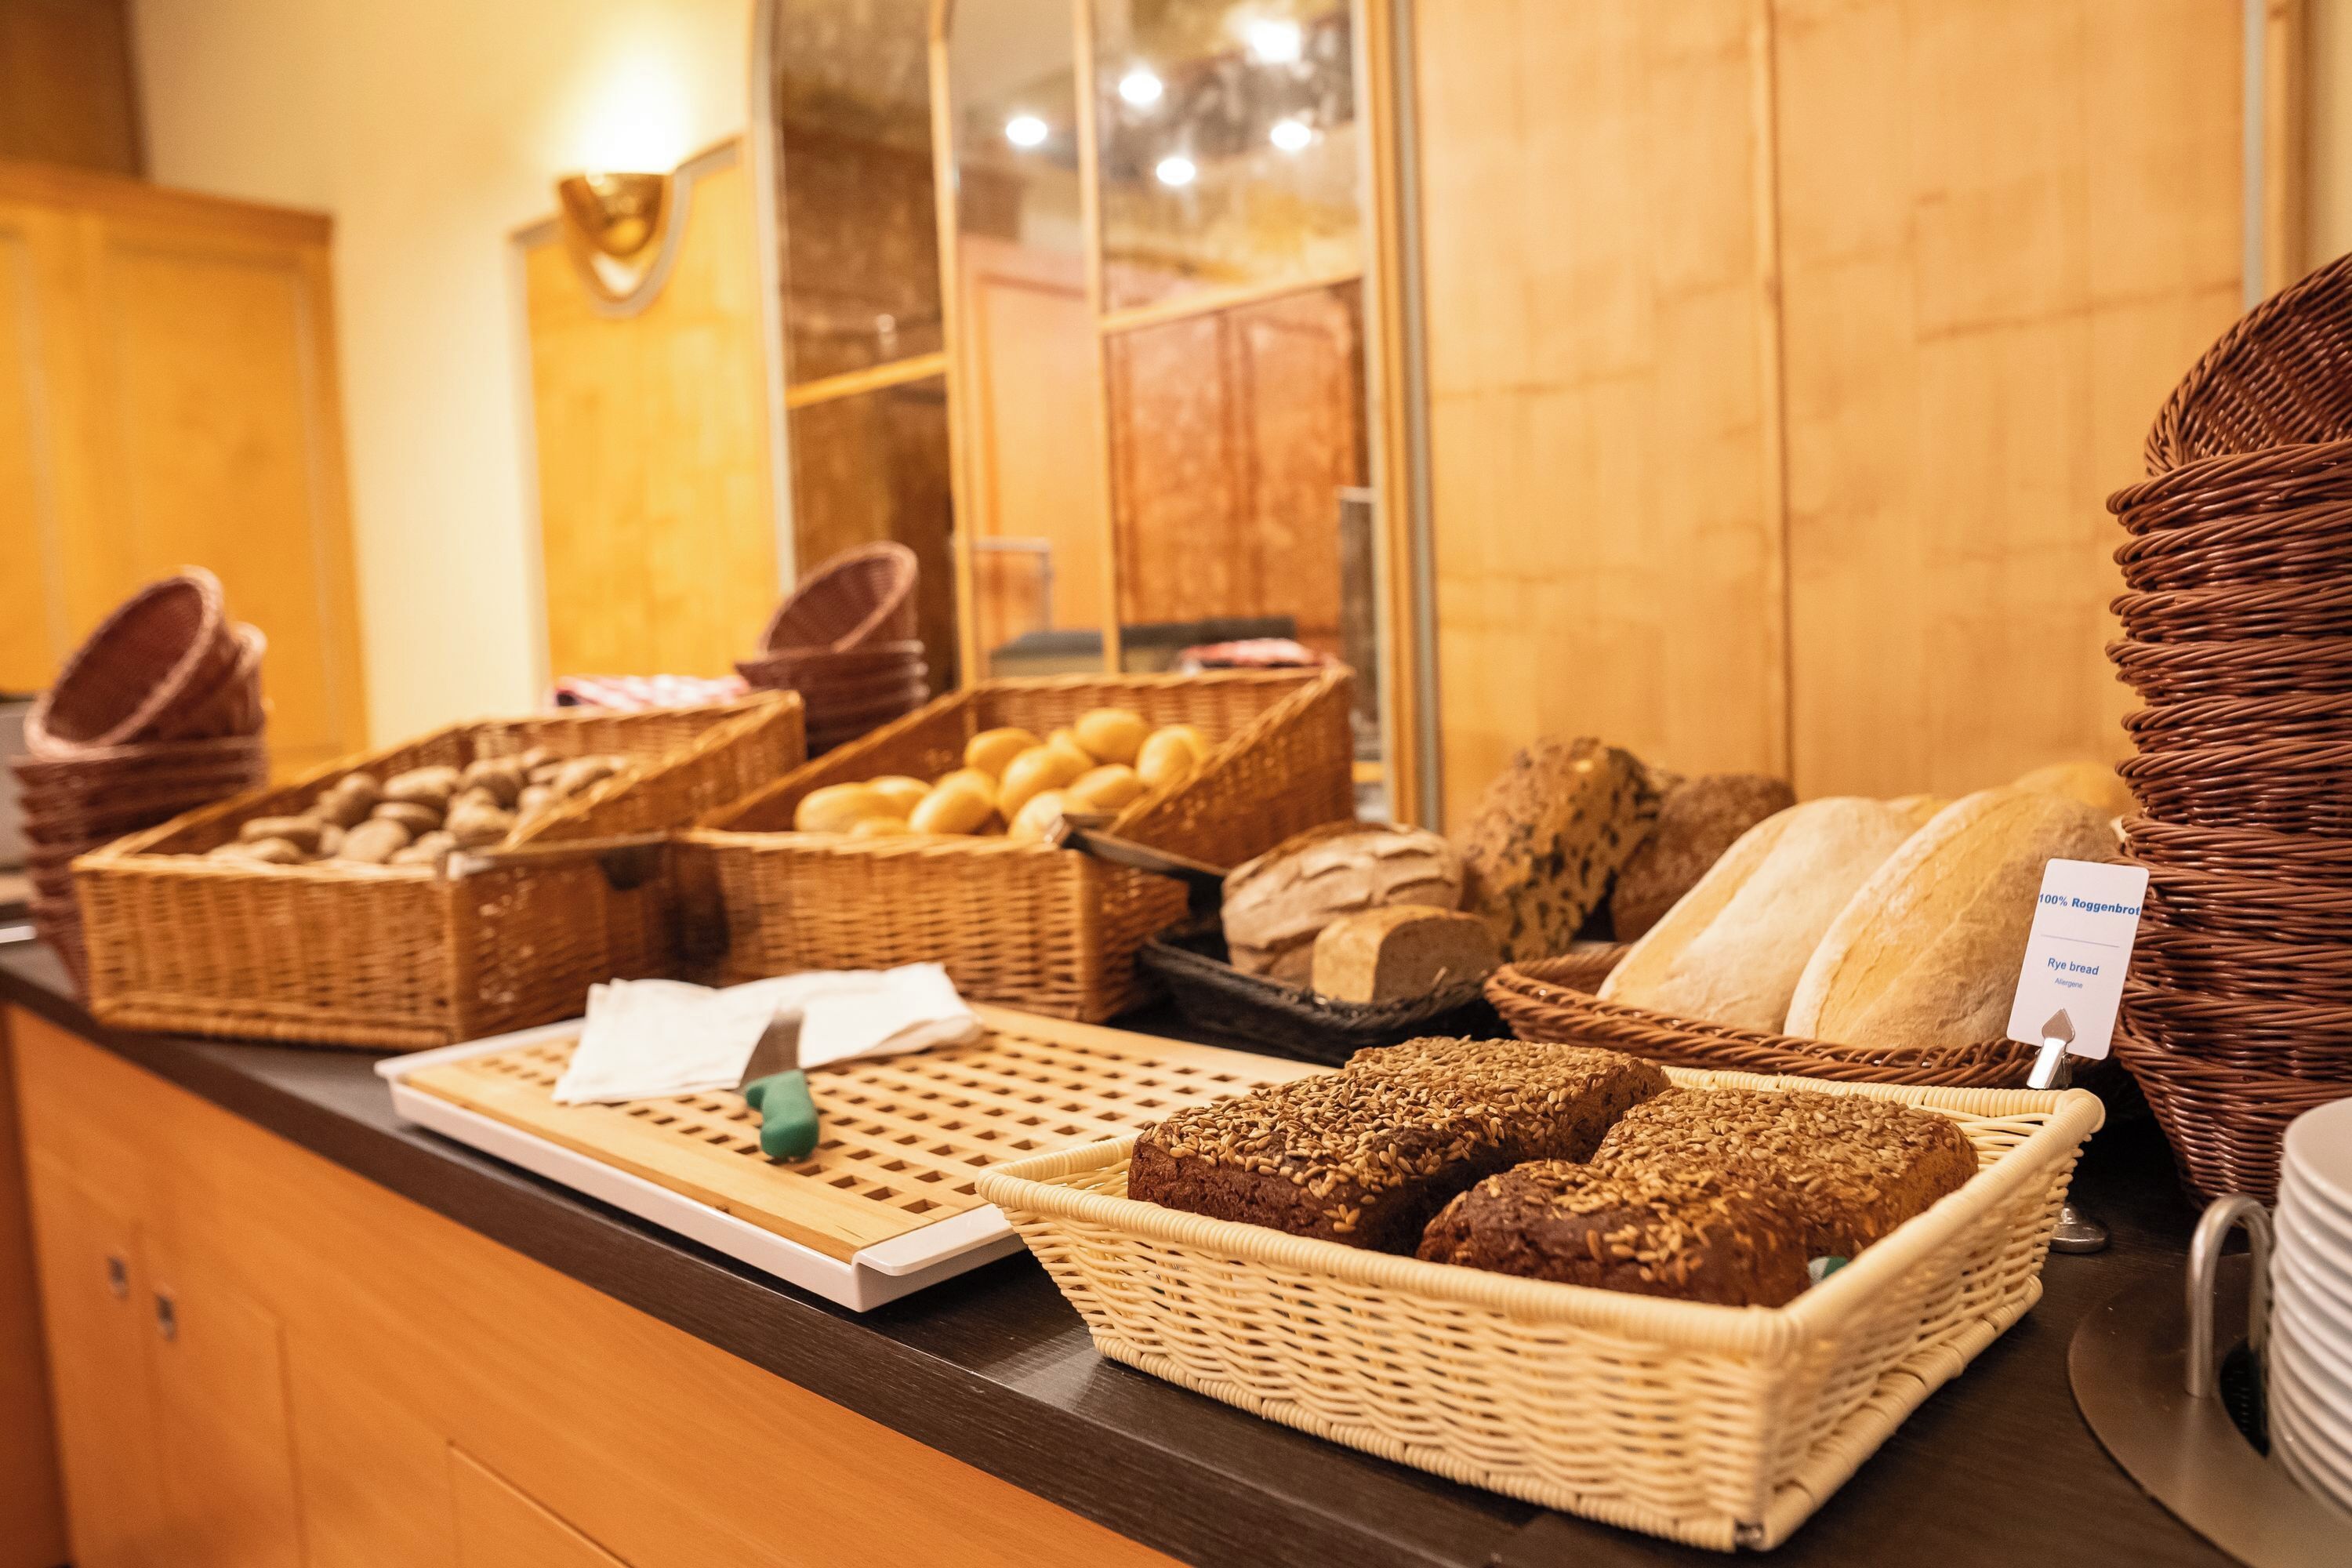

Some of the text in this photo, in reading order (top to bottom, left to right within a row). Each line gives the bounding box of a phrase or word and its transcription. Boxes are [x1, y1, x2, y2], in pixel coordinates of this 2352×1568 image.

[2039, 893, 2140, 916] 100% Roggenbrot
[2048, 957, 2099, 975] Rye bread
[2055, 978, 2082, 988] Allergene
